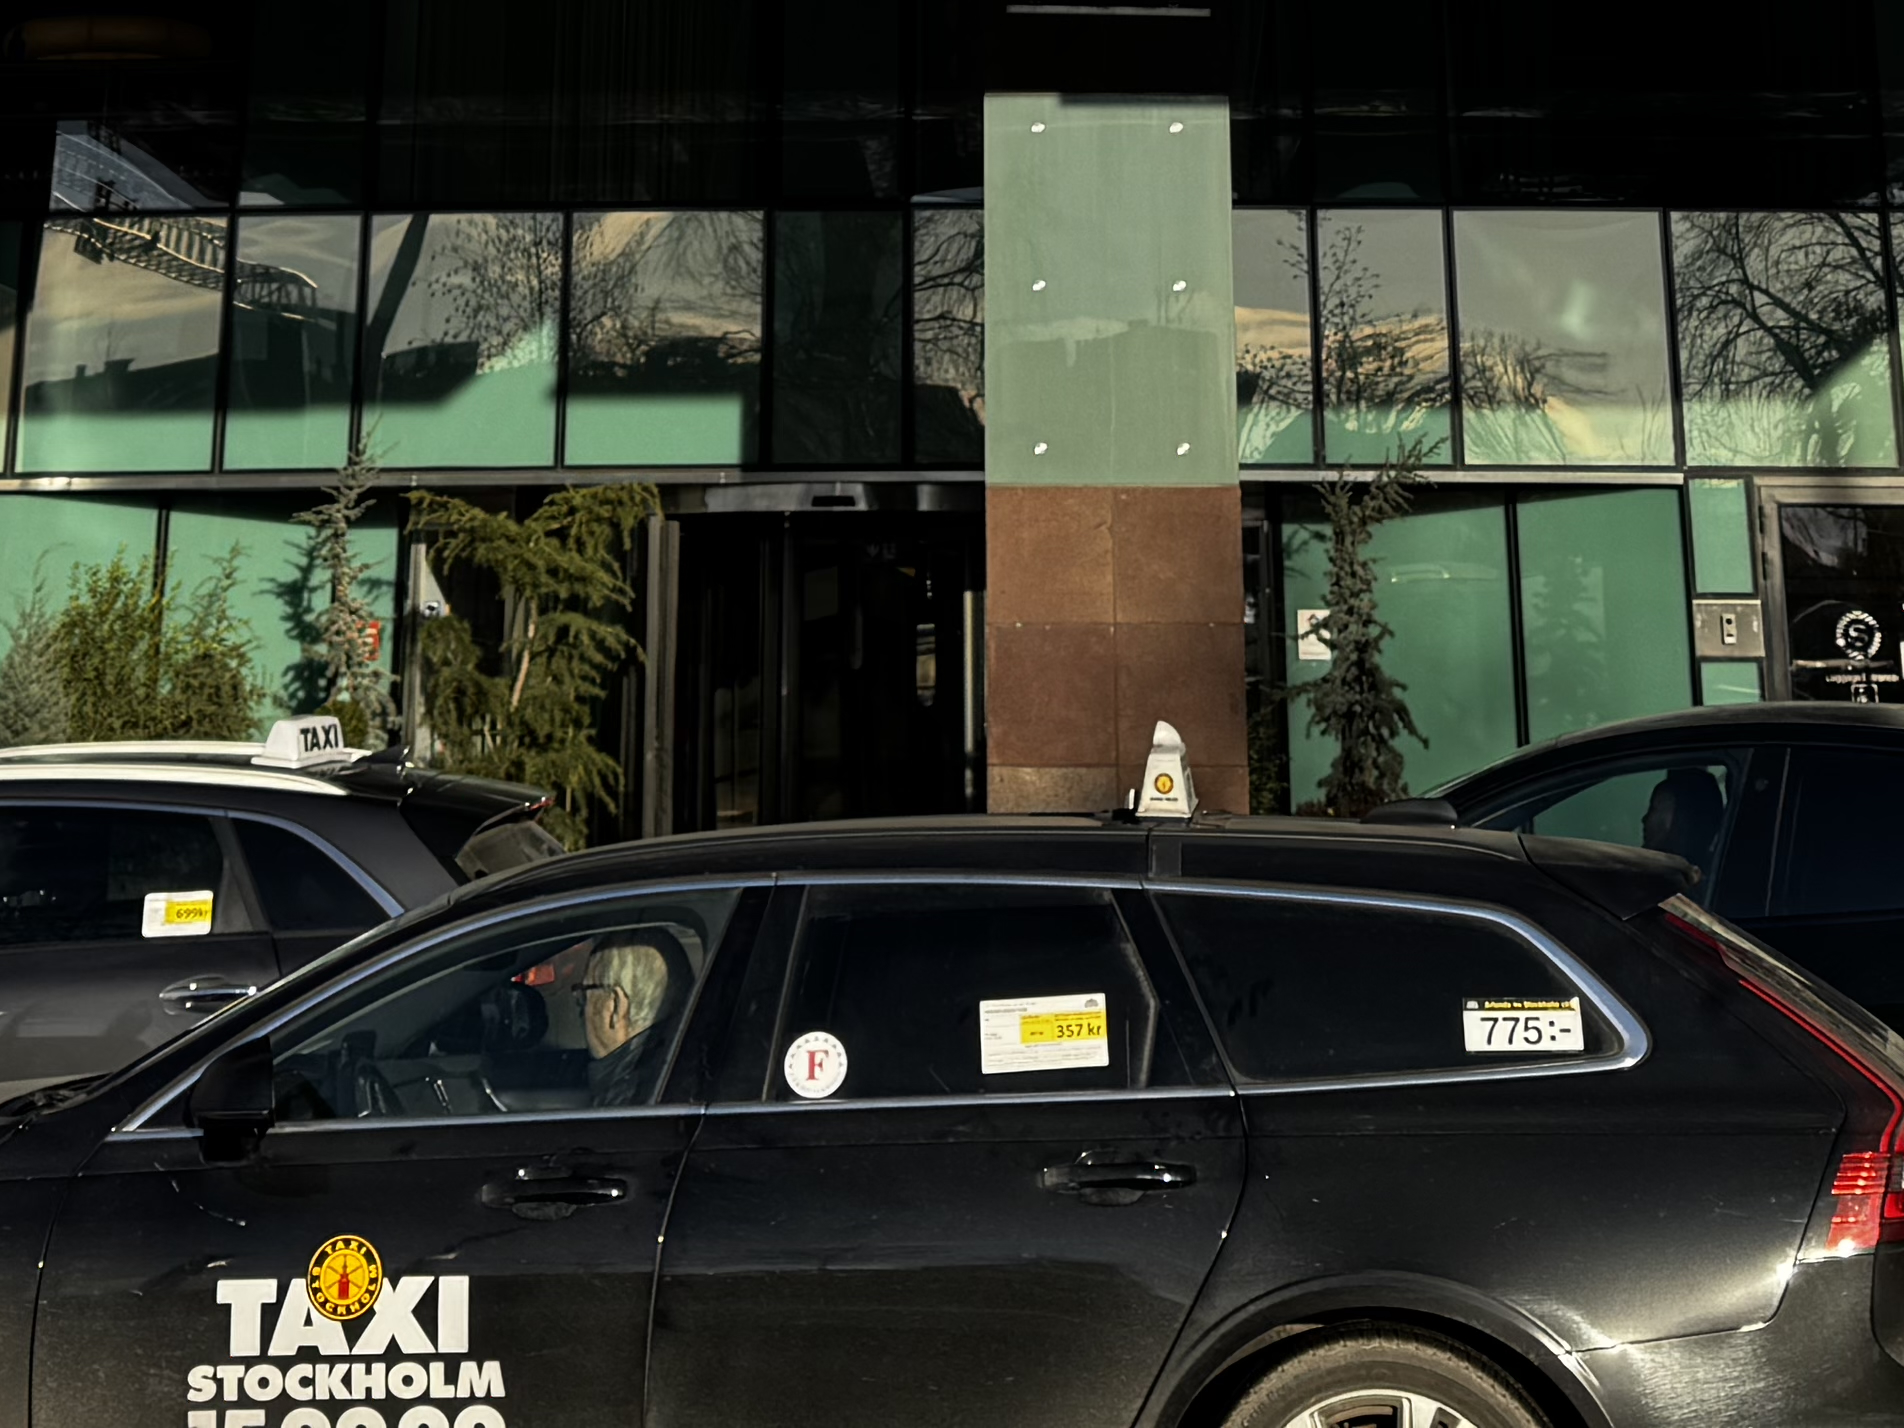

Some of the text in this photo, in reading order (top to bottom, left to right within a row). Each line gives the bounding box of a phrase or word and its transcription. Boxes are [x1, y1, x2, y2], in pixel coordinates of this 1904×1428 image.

[300, 723, 339, 752] TAXI
[1056, 1022, 1101, 1039] 357 kr
[1480, 1016, 1571, 1046] 775:-
[806, 1049, 830, 1081] F
[216, 1275, 469, 1357] TAXI
[187, 1360, 507, 1403] STOCKHOLM
